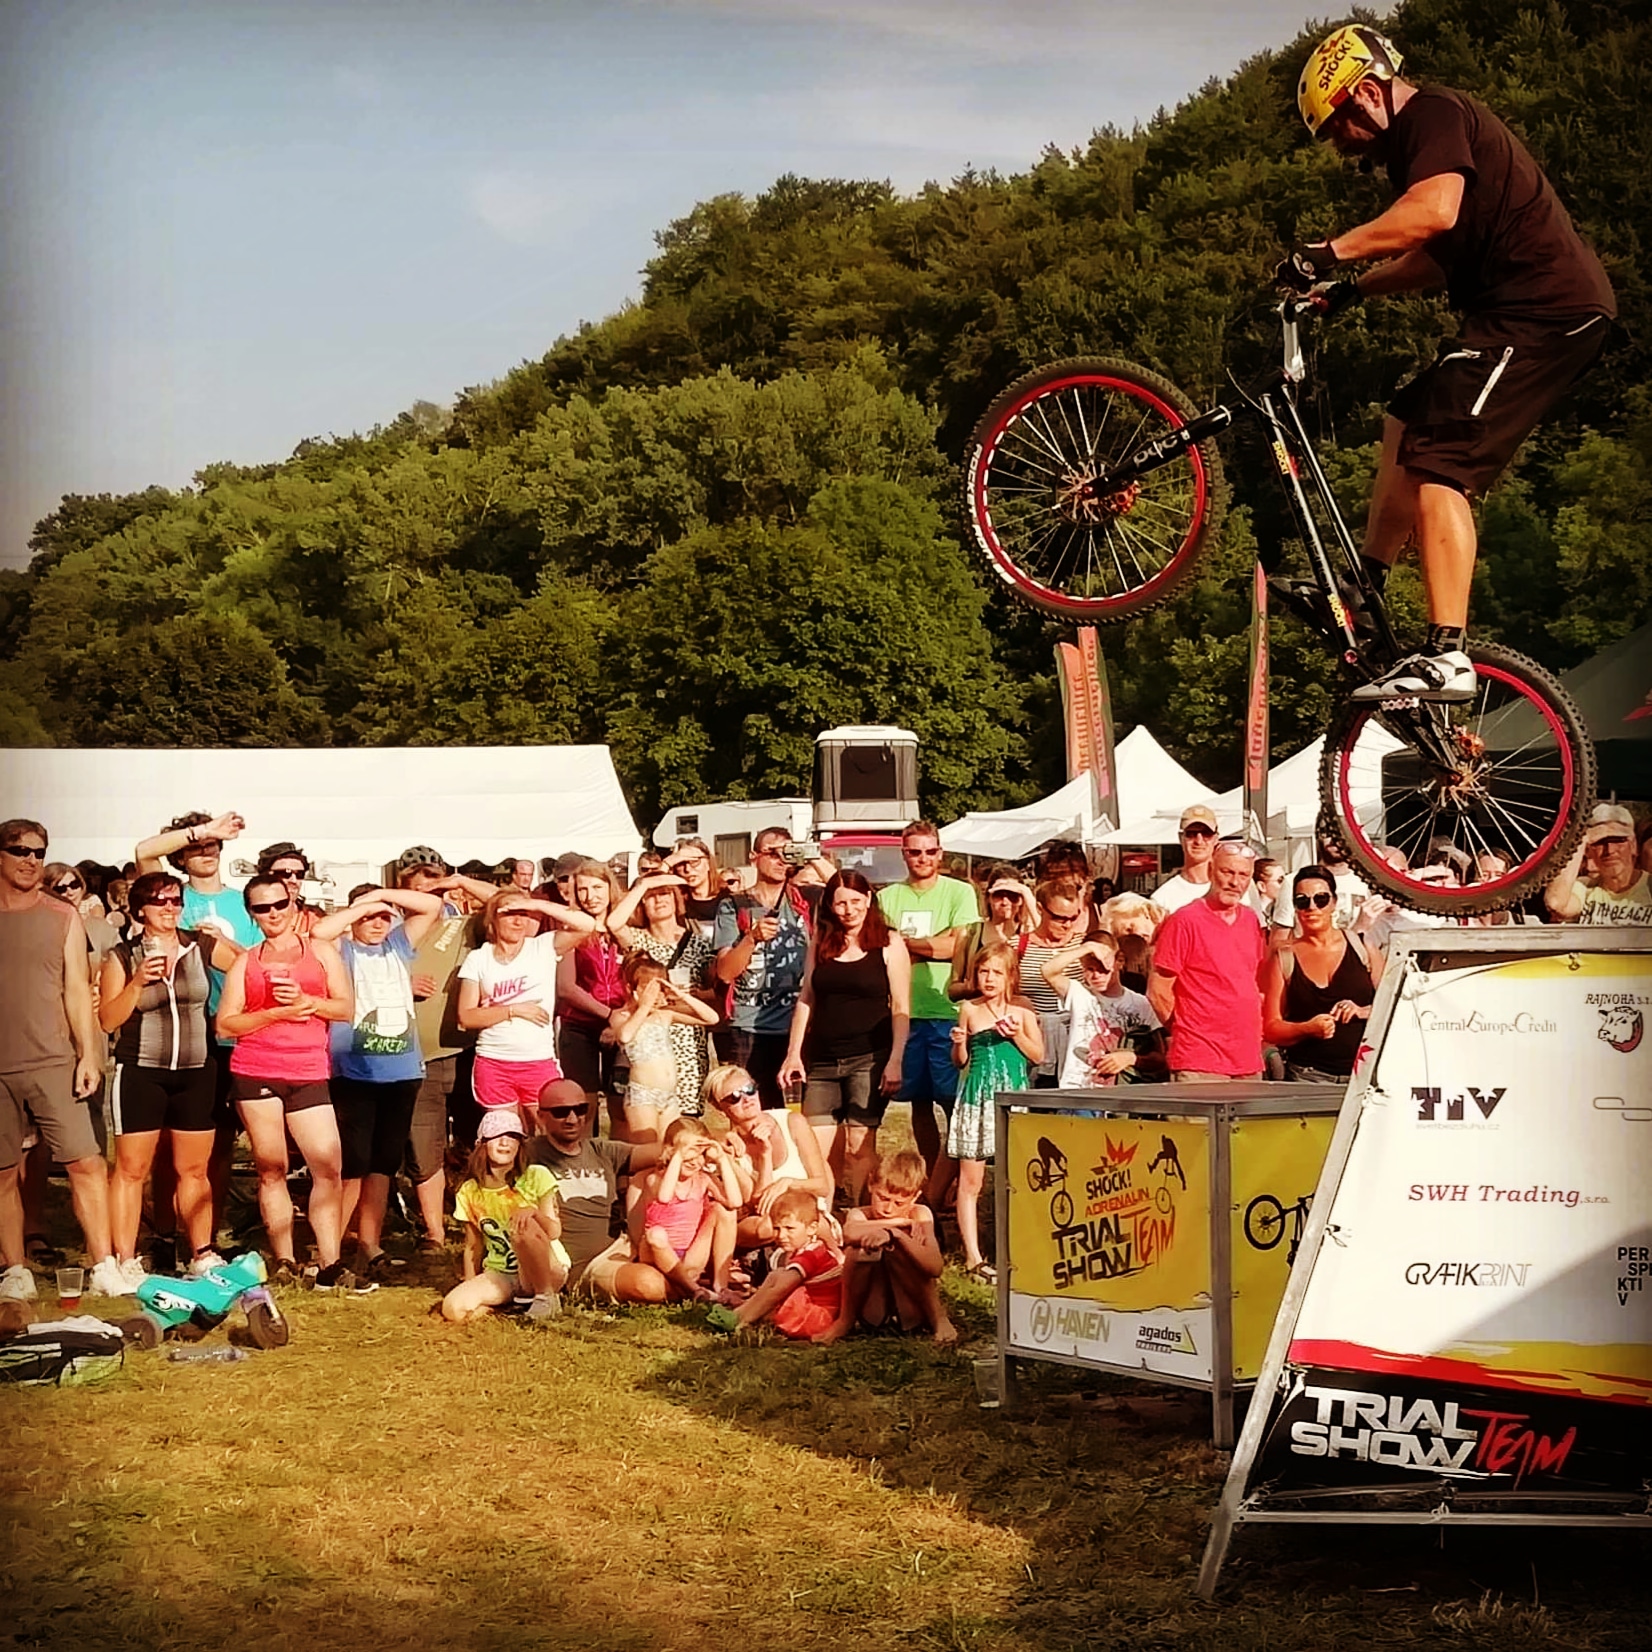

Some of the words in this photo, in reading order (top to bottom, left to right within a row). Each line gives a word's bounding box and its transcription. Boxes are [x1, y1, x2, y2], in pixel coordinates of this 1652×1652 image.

[1319, 40, 1354, 91] SHOCK!
[967, 443, 983, 519] ROCKET
[493, 976, 528, 998] NIKE
[1086, 1169, 1132, 1200] SHOCK!
[1408, 1184, 1470, 1202] SWH
[1478, 1185, 1581, 1208] Trading
[1085, 1187, 1151, 1218] ADRENALIN
[1051, 1213, 1131, 1260] TRIAL
[1120, 1205, 1176, 1268] TEAM
[1052, 1242, 1132, 1290] SHOW
[1617, 1246, 1649, 1261] PER
[1617, 1277, 1643, 1291] KTI
[1617, 1292, 1629, 1306] V
[1056, 1306, 1111, 1343] HAVEN
[1138, 1325, 1182, 1343] agados
[1290, 1421, 1477, 1470] SHOW
[1304, 1385, 1478, 1441] TRIAL
[1459, 1407, 1577, 1491] TEAM
